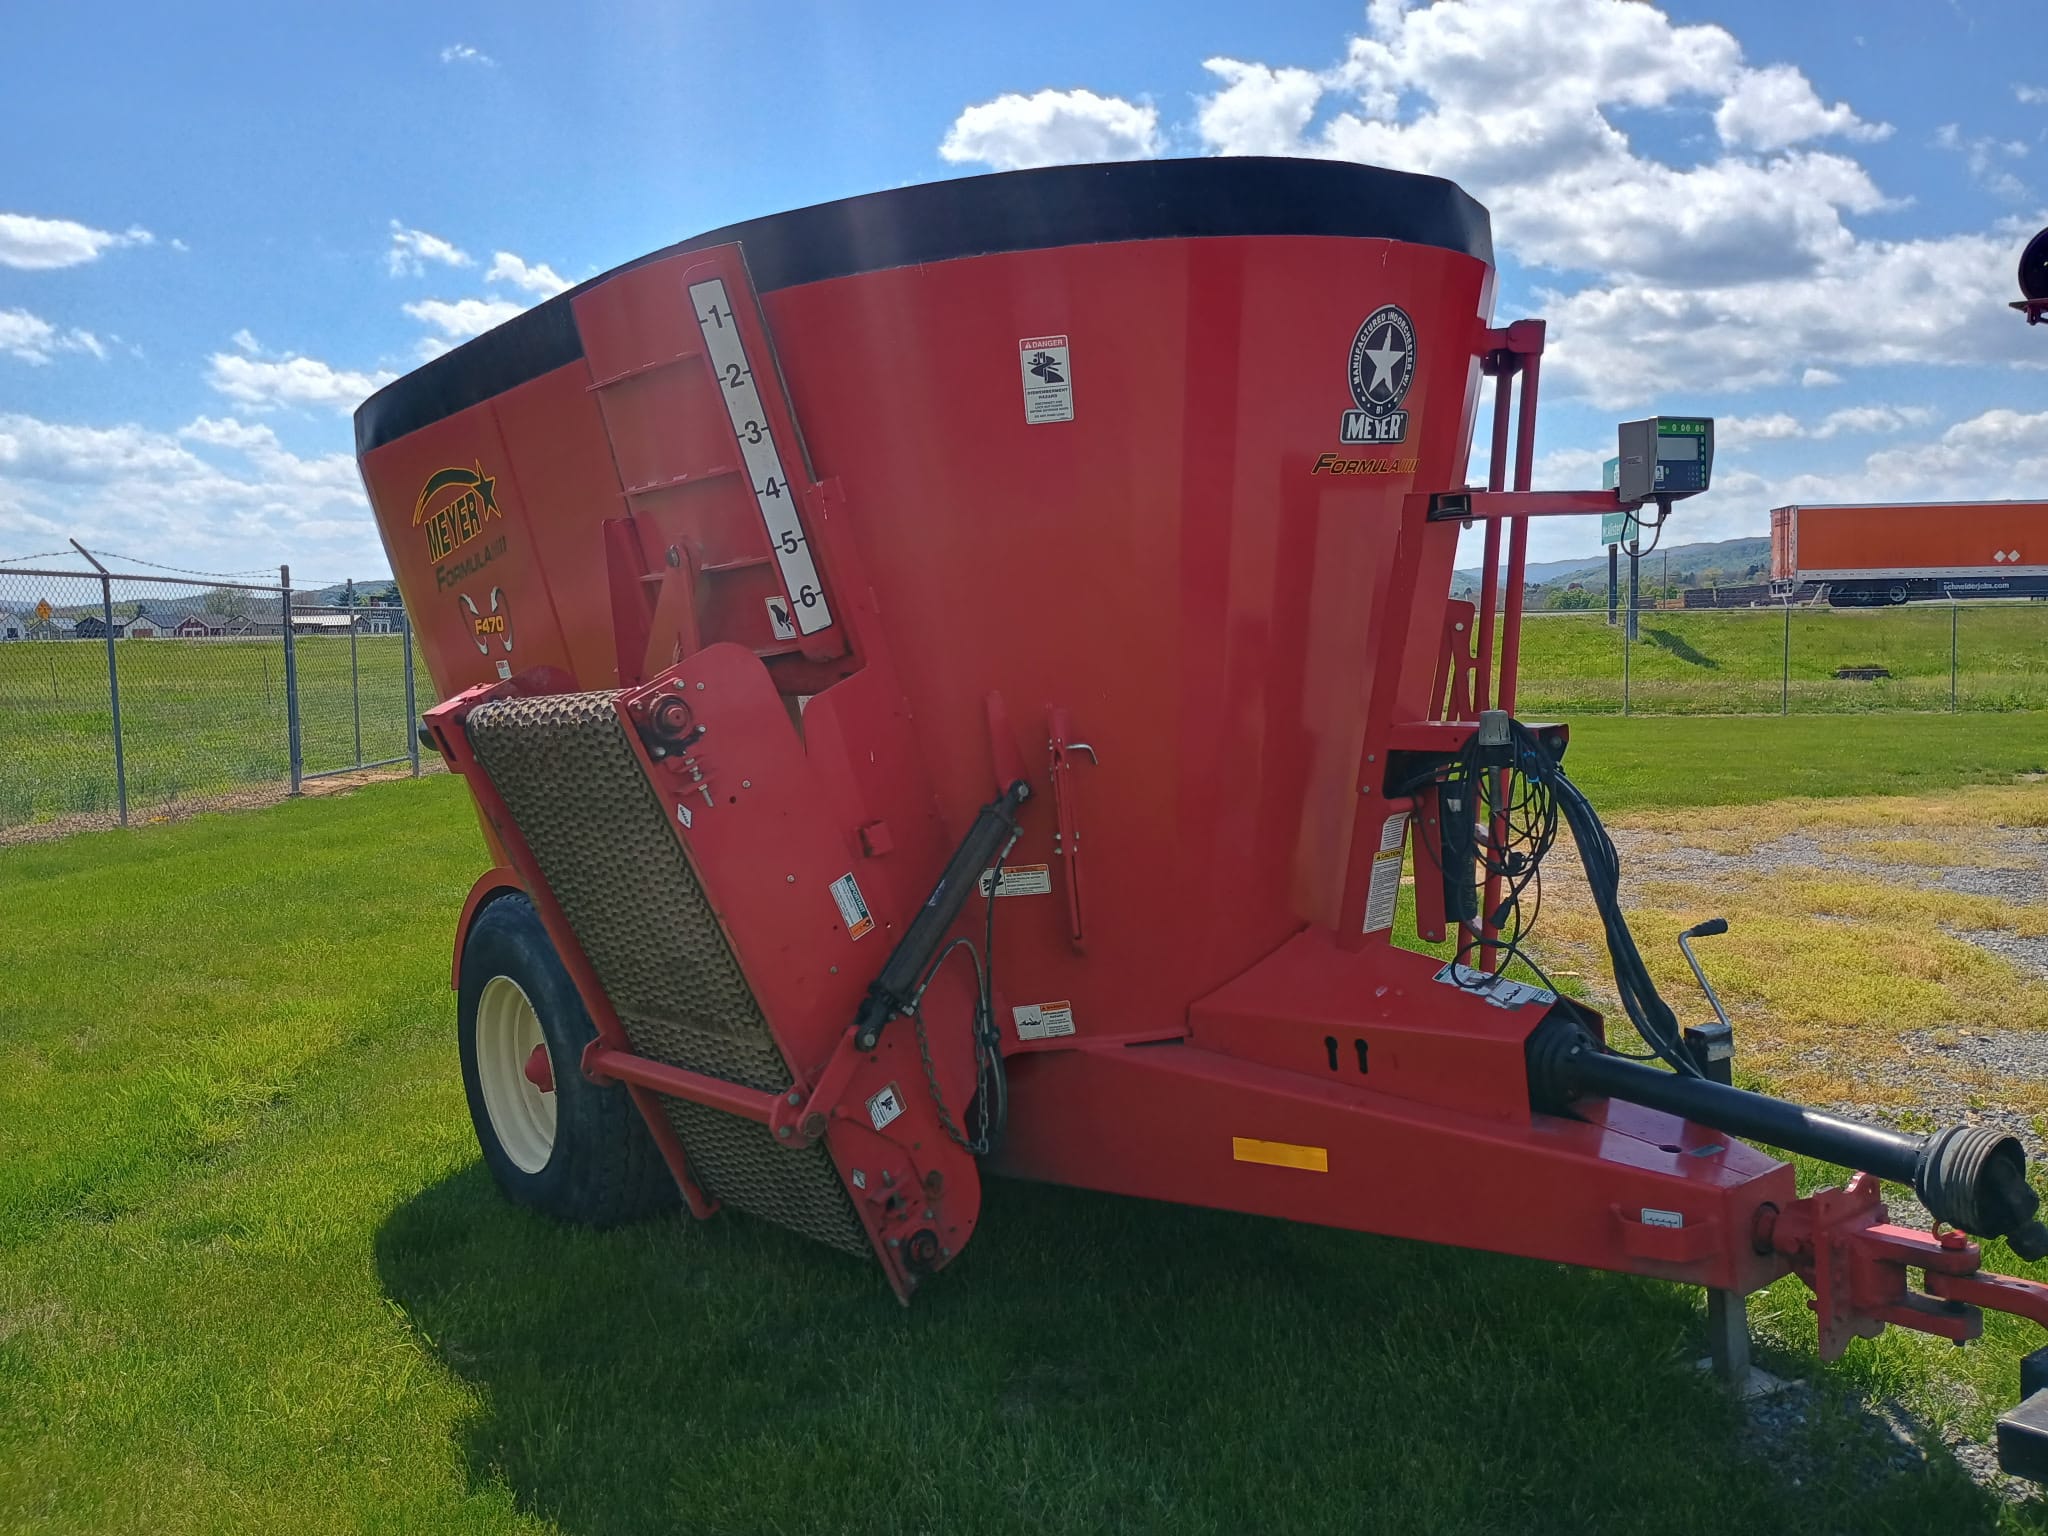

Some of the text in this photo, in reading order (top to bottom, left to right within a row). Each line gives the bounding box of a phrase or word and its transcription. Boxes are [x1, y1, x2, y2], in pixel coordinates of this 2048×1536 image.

[707, 304, 724, 329] 1
[1032, 339, 1063, 349] DANGER
[1353, 313, 1386, 385] MANUFACTURED
[725, 363, 745, 388] 2
[744, 420, 763, 445] 3
[1347, 414, 1401, 439] MEYER
[762, 476, 781, 500] 4
[424, 489, 482, 564] MEYER
[780, 530, 798, 556] 5
[799, 584, 817, 609] 6
[474, 615, 505, 636] F470
[1380, 850, 1401, 859] CAUTION
[848, 880, 866, 913] IMPORTANT
